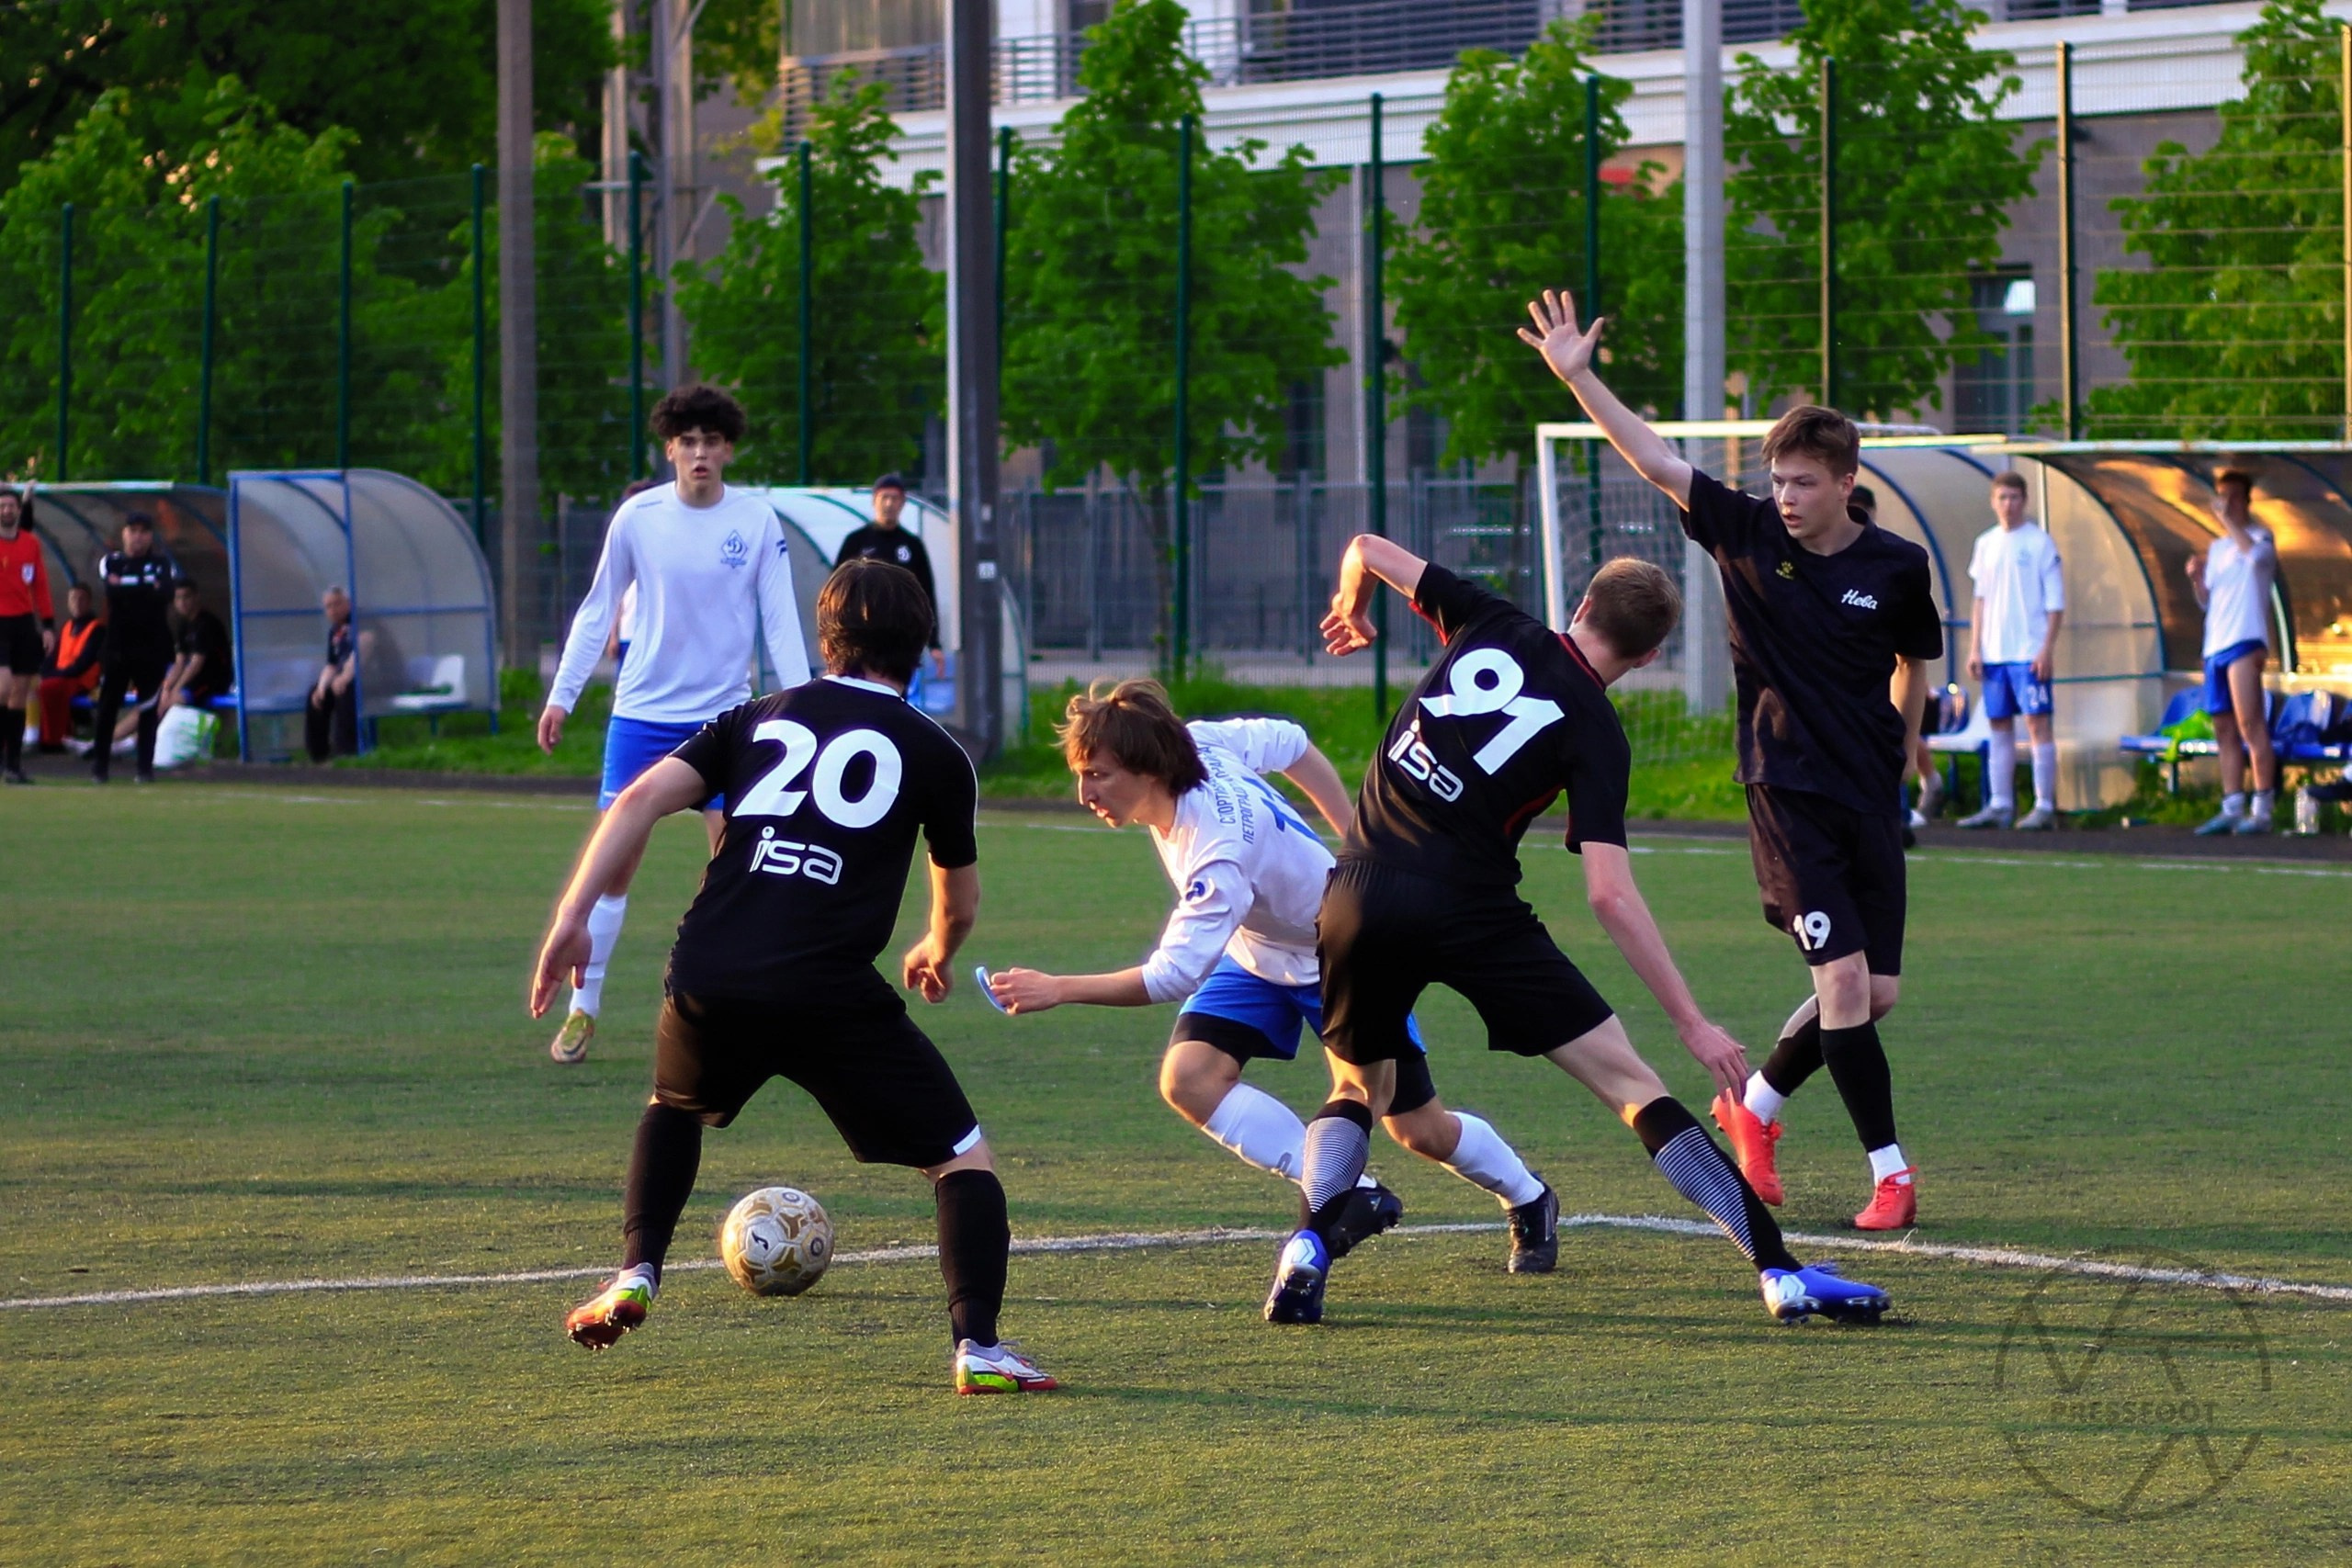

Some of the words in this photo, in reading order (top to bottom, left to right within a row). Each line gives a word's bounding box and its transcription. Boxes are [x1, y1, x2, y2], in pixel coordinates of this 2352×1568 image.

[1840, 589, 1878, 610] Нева
[1419, 648, 1565, 775] 91
[731, 719, 902, 829] 20
[1387, 718, 1464, 802] isa
[749, 826, 842, 885] isa
[1792, 910, 1831, 951] 19
